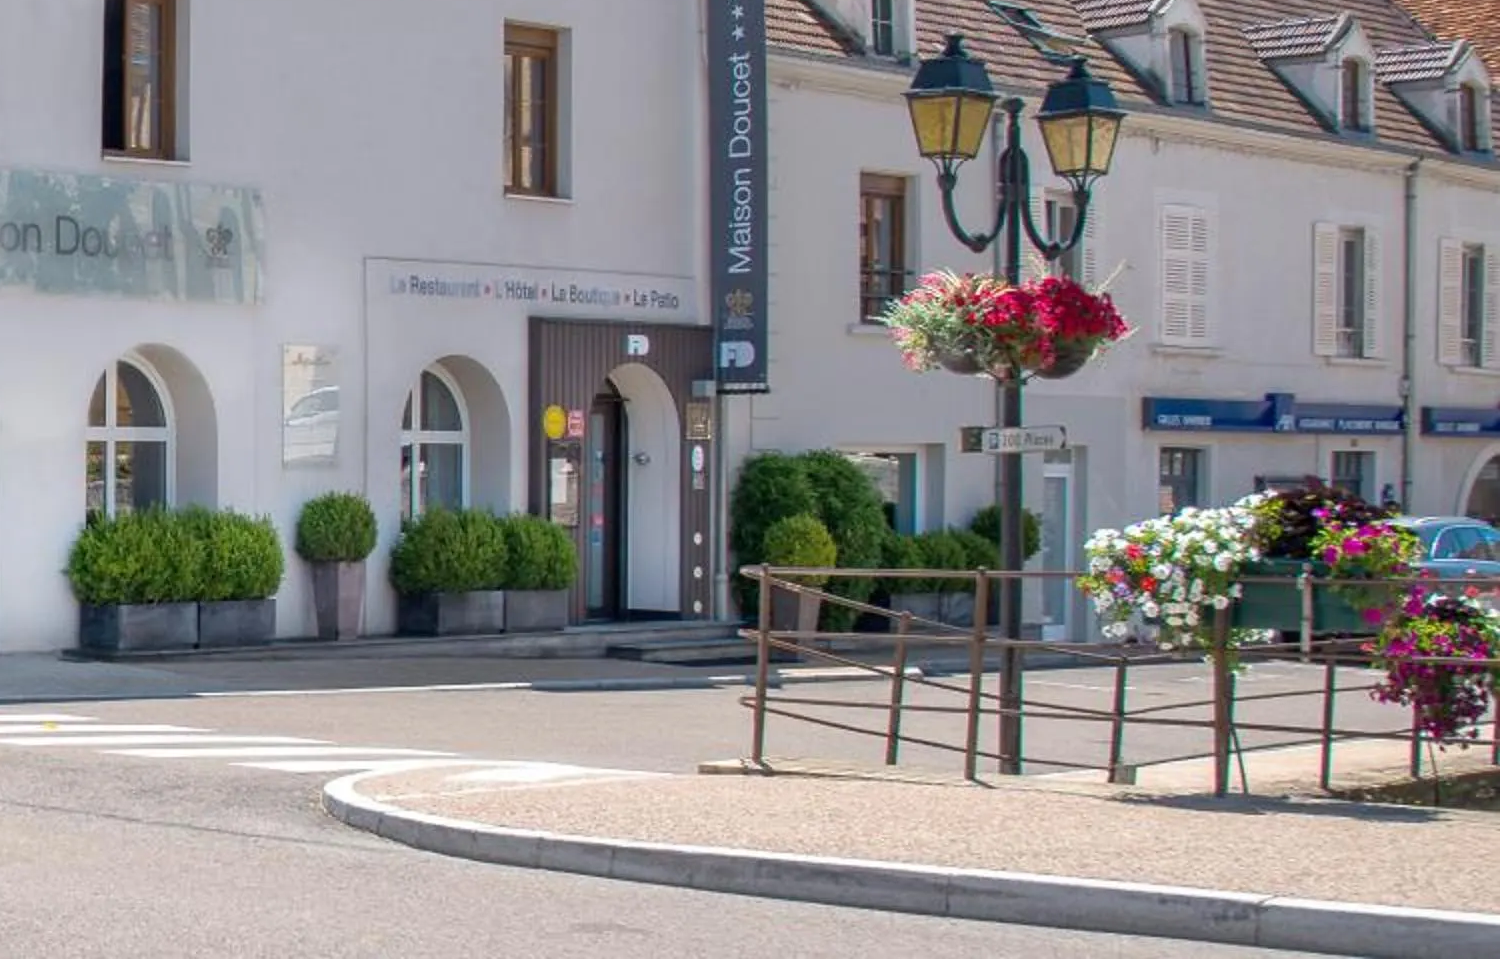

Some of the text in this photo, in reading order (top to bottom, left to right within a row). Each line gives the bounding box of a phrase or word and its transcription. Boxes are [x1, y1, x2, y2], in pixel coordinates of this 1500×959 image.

[728, 51, 752, 274] Maison Doucet
[55, 215, 174, 262] Doucet
[409, 274, 481, 298] Restaurant
[568, 284, 621, 307] Boutique
[632, 288, 648, 306] Le
[650, 289, 679, 309] Patio
